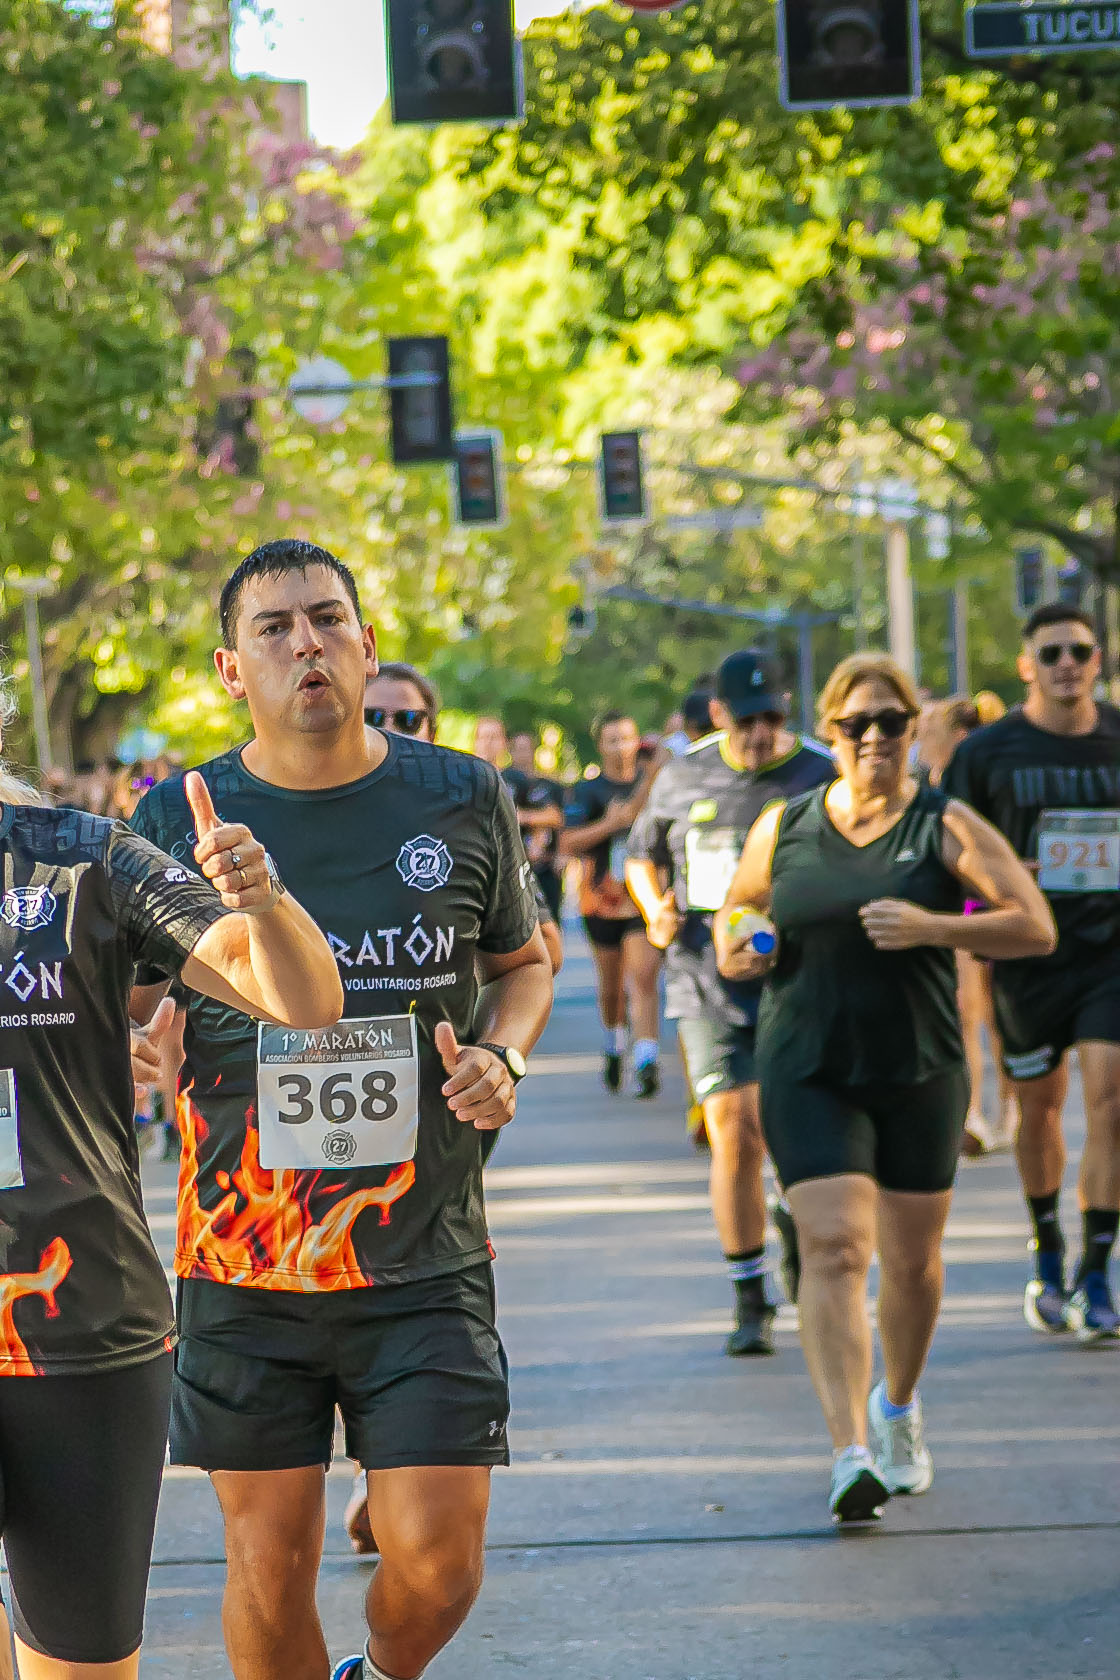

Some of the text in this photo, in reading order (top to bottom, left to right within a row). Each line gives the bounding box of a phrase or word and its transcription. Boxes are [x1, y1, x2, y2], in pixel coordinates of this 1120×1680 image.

[1022, 10, 1120, 41] TUCU
[1049, 841, 1111, 870] 921
[327, 913, 455, 967] RATÓN
[345, 972, 457, 991] VOLUNTARIOS ROSARIO
[31, 1012, 76, 1026] ROSARIO
[302, 1023, 393, 1051] MARATÓN
[277, 1070, 398, 1125] 368
[332, 1139, 347, 1152] 27
